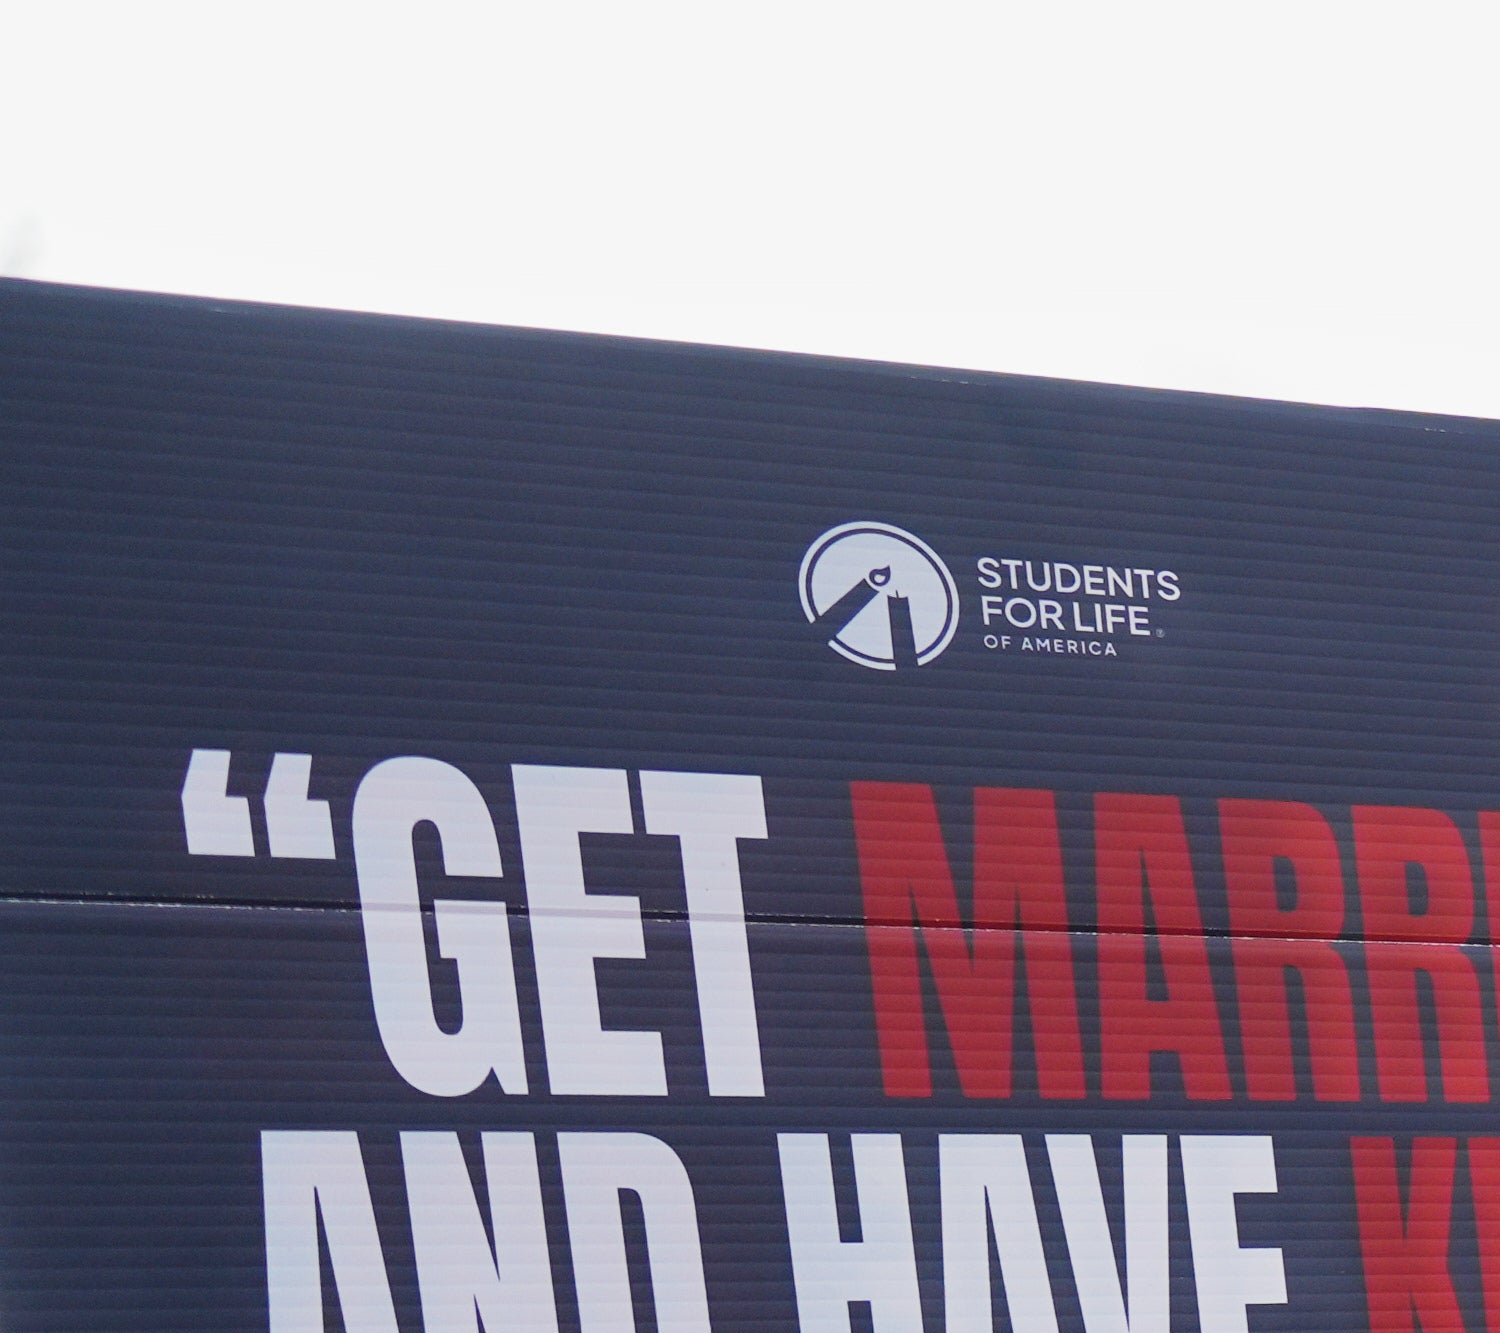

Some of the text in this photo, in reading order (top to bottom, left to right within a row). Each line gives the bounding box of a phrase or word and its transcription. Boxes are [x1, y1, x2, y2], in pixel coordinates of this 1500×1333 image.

[977, 556, 1181, 601] STUDENTS
[981, 596, 1151, 636] FOR LIFE
[983, 634, 1118, 657] OF AMERICA
[181, 748, 769, 1098] “GET
